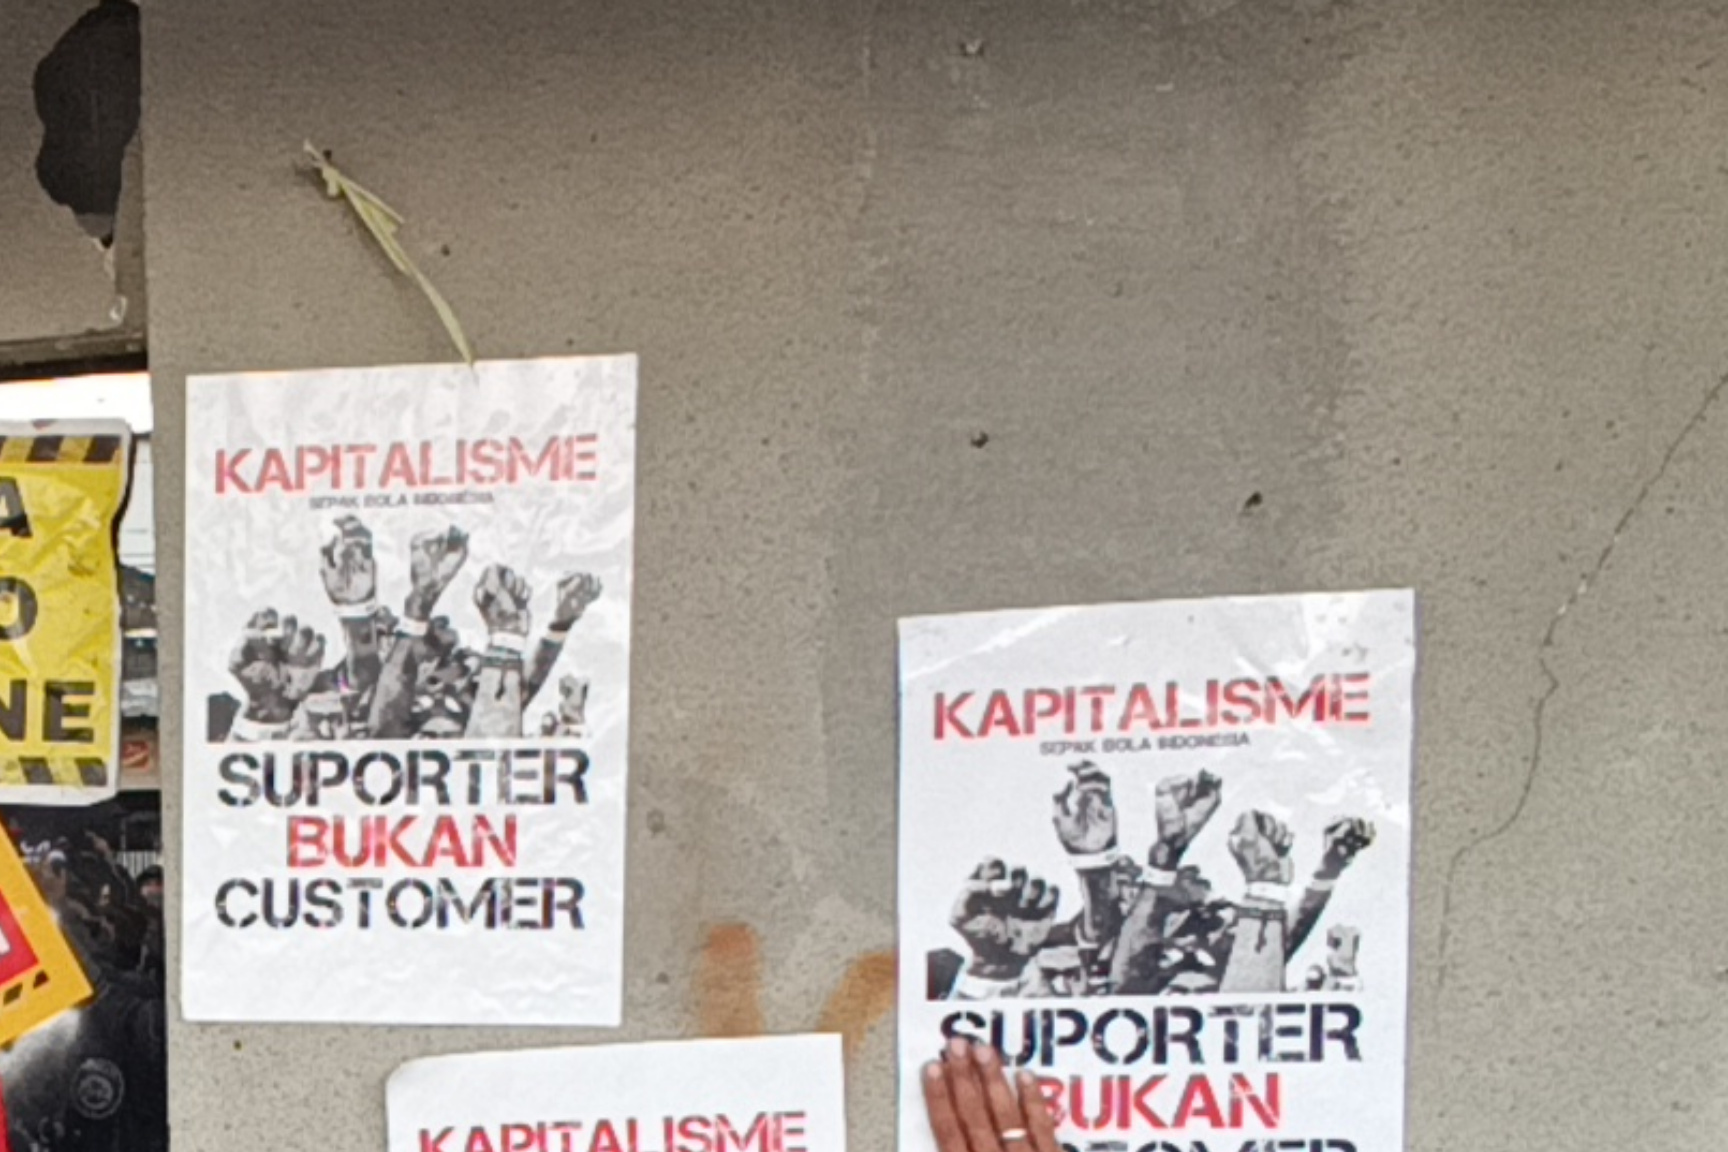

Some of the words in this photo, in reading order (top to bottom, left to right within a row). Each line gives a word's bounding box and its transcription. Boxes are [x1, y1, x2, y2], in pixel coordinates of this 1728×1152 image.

[215, 433, 599, 495] KAPITALISME
[932, 672, 1371, 741] KAPITALISME
[216, 749, 591, 808] SUPORTER
[286, 814, 518, 868] BUKAN
[215, 877, 586, 930] CUSTOMER
